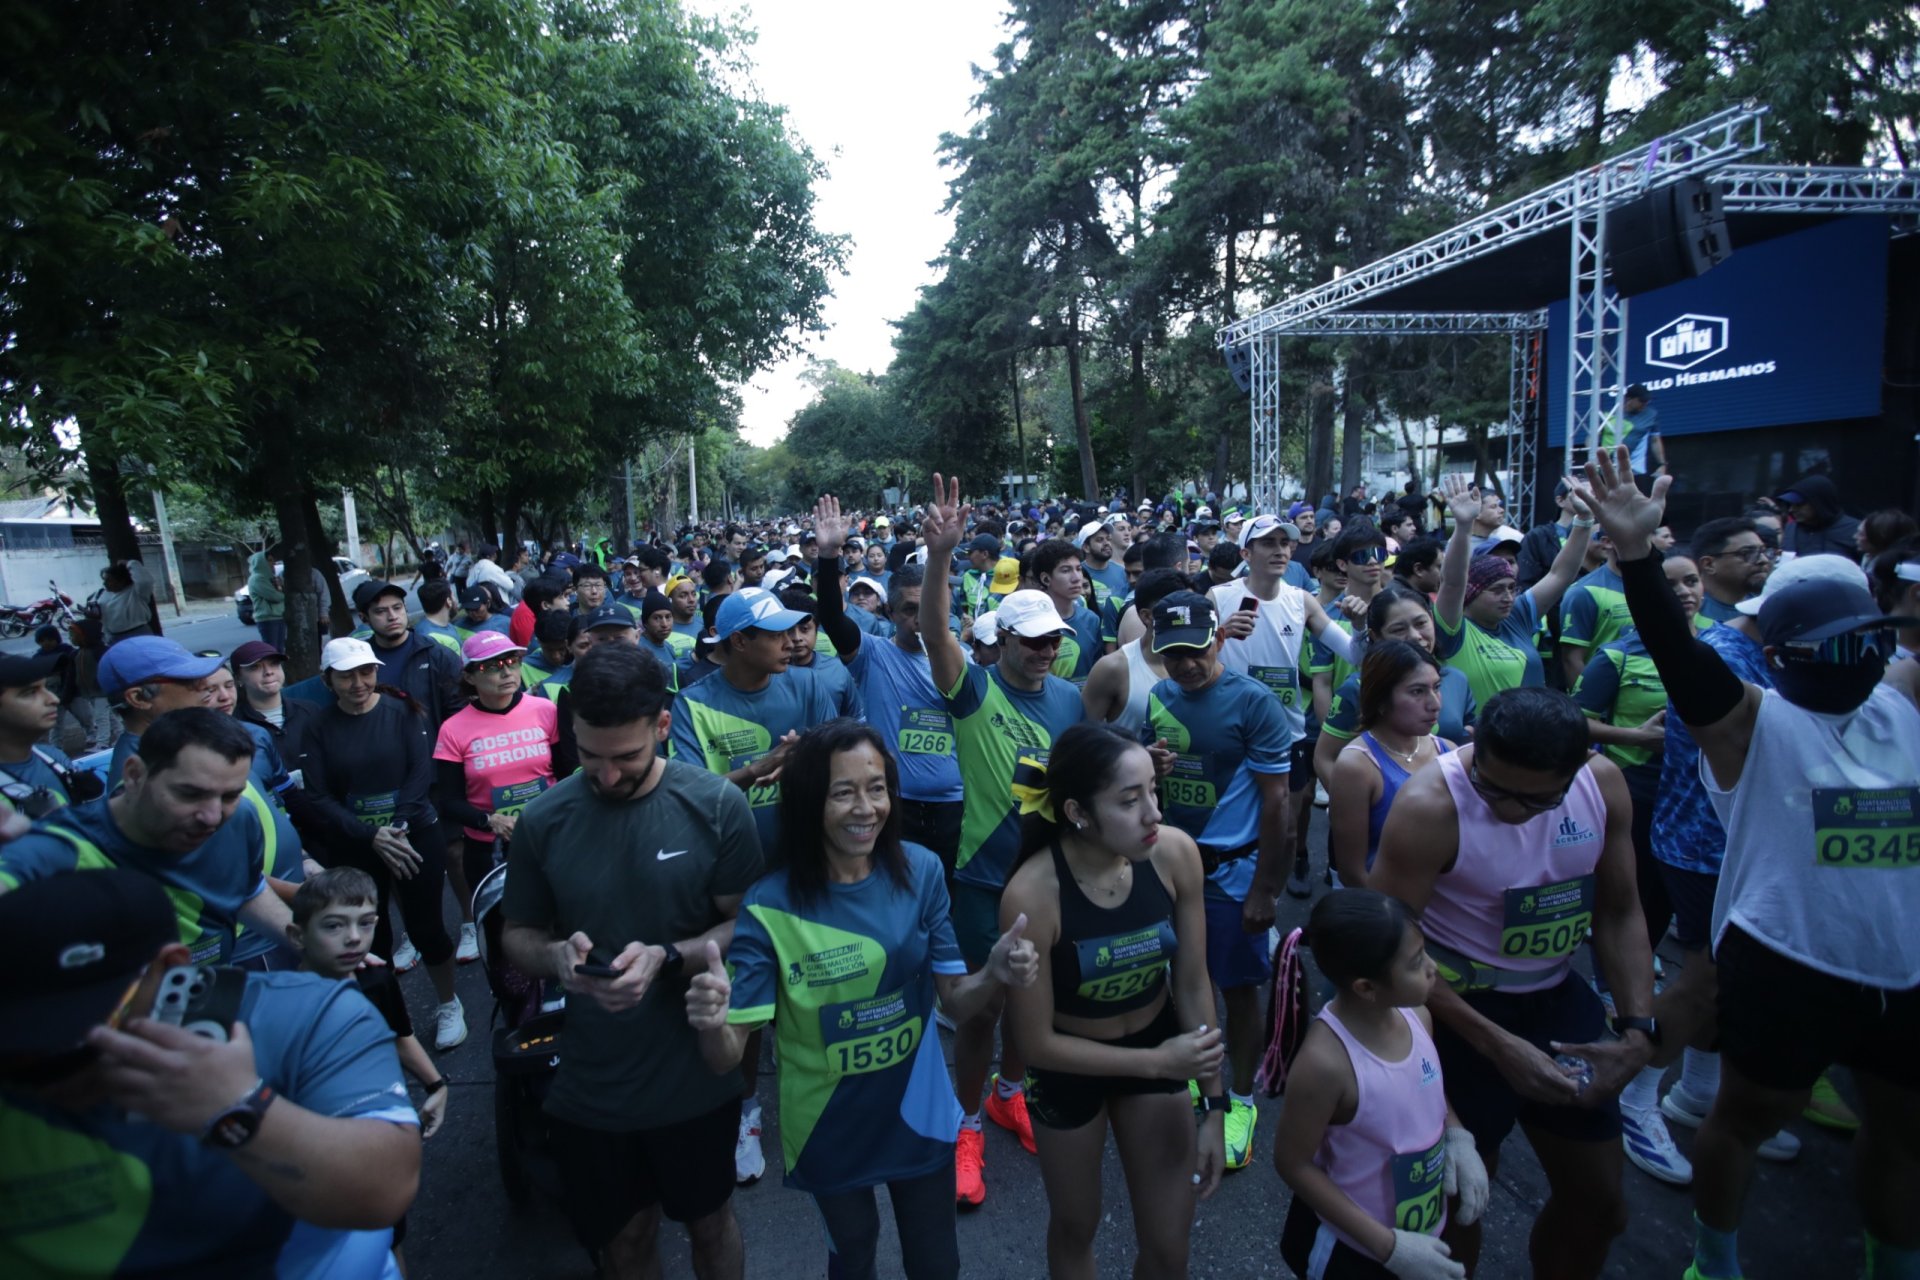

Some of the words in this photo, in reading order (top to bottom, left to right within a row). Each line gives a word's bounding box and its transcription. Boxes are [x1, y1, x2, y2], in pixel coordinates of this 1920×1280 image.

[1675, 360, 1777, 389] HERMANOS
[471, 726, 546, 754] BOSTON
[904, 733, 947, 753] 1266
[474, 741, 549, 771] STRONG
[1164, 781, 1207, 804] 1358
[1822, 832, 1920, 864] 0345
[1504, 917, 1588, 955] 0505
[806, 953, 864, 971] GUATEMALTECOS
[825, 960, 866, 977] NUTRICIÓN
[1089, 966, 1163, 999] 1520
[838, 1027, 913, 1072] 1530
